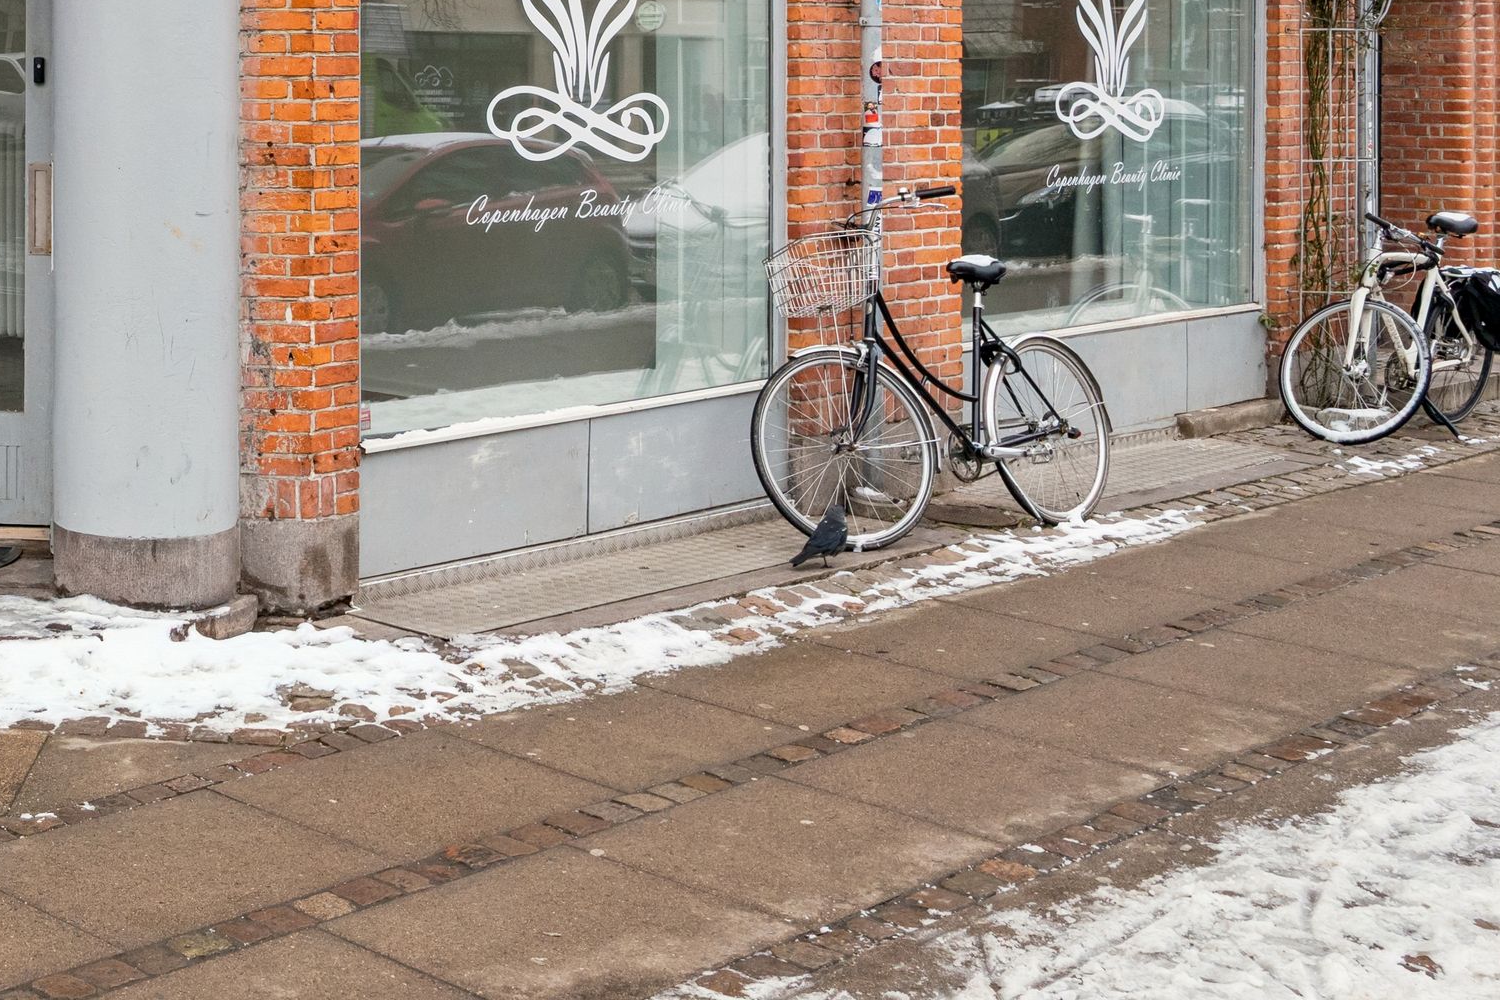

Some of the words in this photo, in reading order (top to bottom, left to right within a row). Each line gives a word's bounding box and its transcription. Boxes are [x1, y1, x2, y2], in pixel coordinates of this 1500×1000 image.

[1046, 164, 1107, 194] Copenhagen
[1110, 161, 1148, 191] Beauty
[1150, 159, 1181, 182] Clinic
[465, 194, 567, 233] Copenhagen
[575, 188, 637, 227] Beauty
[642, 186, 692, 215] Clinic
